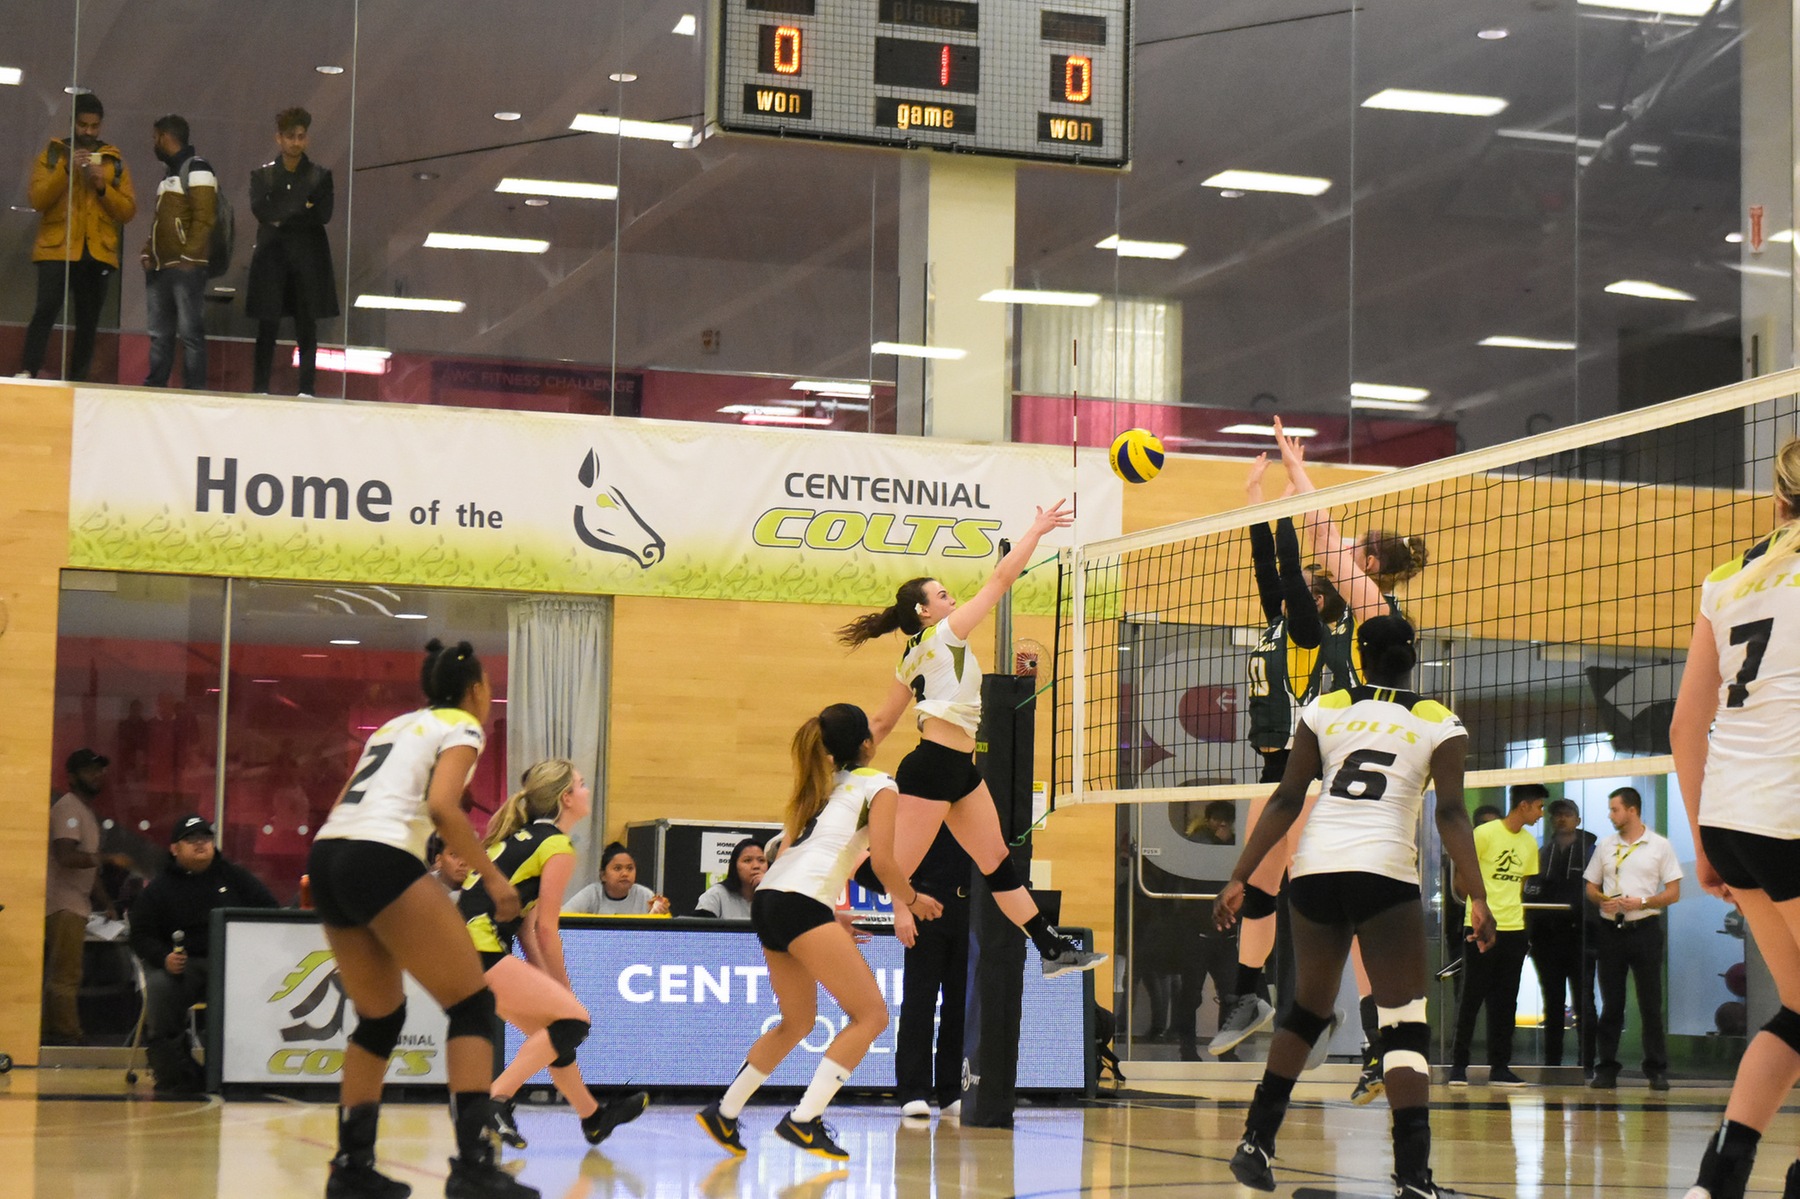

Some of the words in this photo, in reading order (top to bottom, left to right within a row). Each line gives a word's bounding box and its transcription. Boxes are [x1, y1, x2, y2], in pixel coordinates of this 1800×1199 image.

[774, 25, 801, 74] 0
[940, 44, 951, 87] 1
[1065, 55, 1091, 103] 0
[756, 89, 801, 114] won
[897, 103, 954, 131] game
[1049, 118, 1093, 142] won
[481, 371, 540, 388] FITNESS
[545, 376, 635, 394] CHALLENGE
[195, 456, 392, 522] Home
[409, 500, 440, 526] of
[456, 502, 503, 529] the
[784, 472, 991, 510] CENTENNIAL
[752, 506, 1002, 558] COLTS
[1726, 617, 1775, 708] 7
[1325, 720, 1421, 745] COLTS
[1329, 749, 1397, 801] 6
